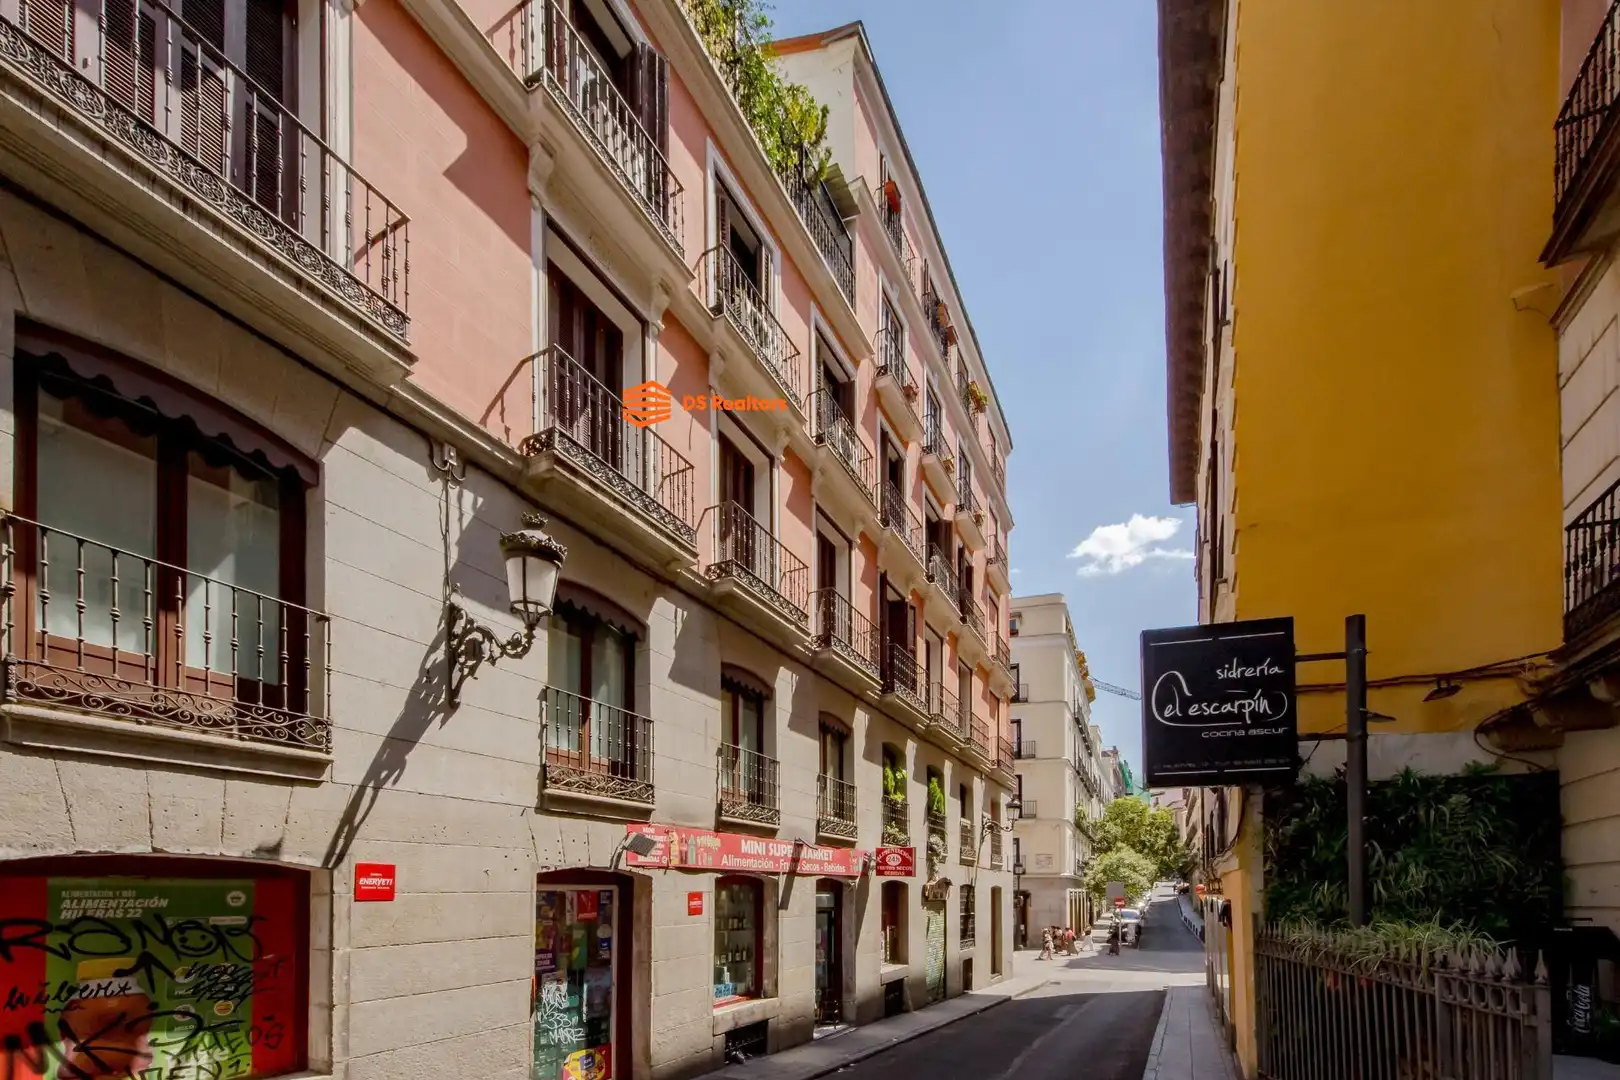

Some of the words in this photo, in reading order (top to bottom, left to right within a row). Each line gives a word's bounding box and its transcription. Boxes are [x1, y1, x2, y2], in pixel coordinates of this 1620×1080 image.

[1215, 657, 1285, 680] sidrería
[1164, 684, 1182, 717] el
[1188, 689, 1273, 724] escarpín
[1201, 730, 1246, 738] cocina
[741, 839, 766, 856] MINI
[721, 854, 774, 870] Alimentación
[801, 861, 820, 872] Secos
[60, 896, 169, 909] ALIMENTACIÓN
[126, 909, 142, 918] 22
